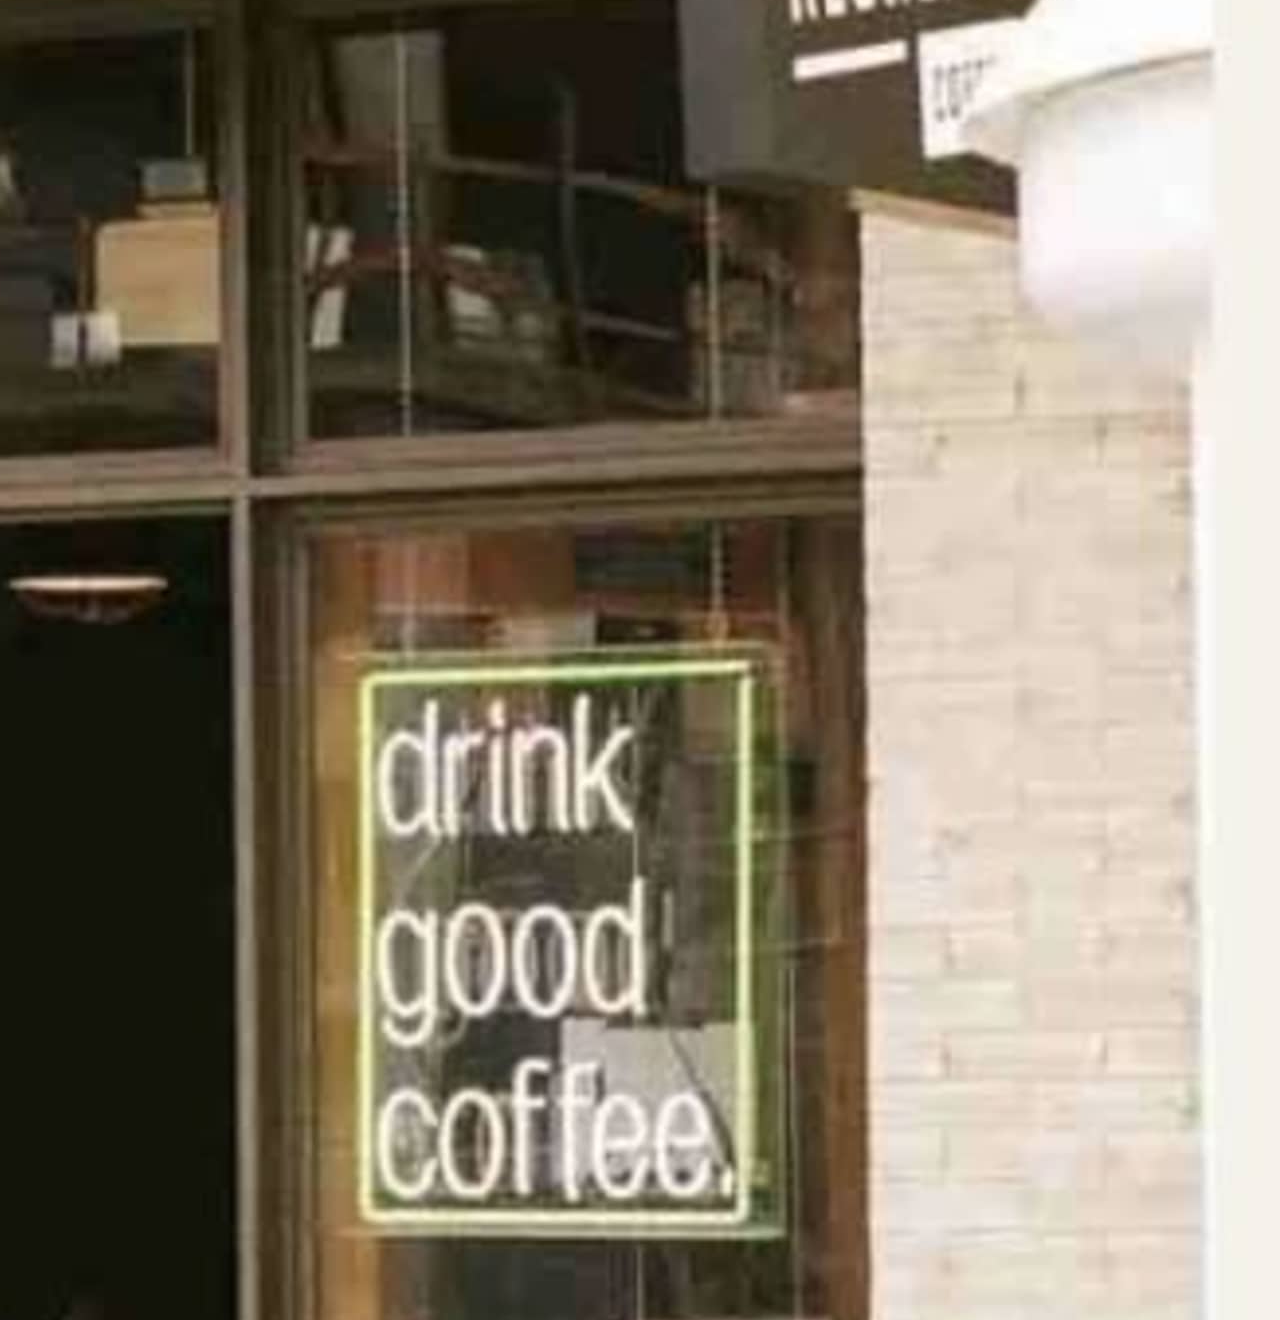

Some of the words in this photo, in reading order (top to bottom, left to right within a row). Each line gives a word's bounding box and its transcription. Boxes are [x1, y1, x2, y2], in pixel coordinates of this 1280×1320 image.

[377, 692, 636, 838] drink
[377, 875, 647, 1047] good
[377, 1057, 735, 1201] coffee.
